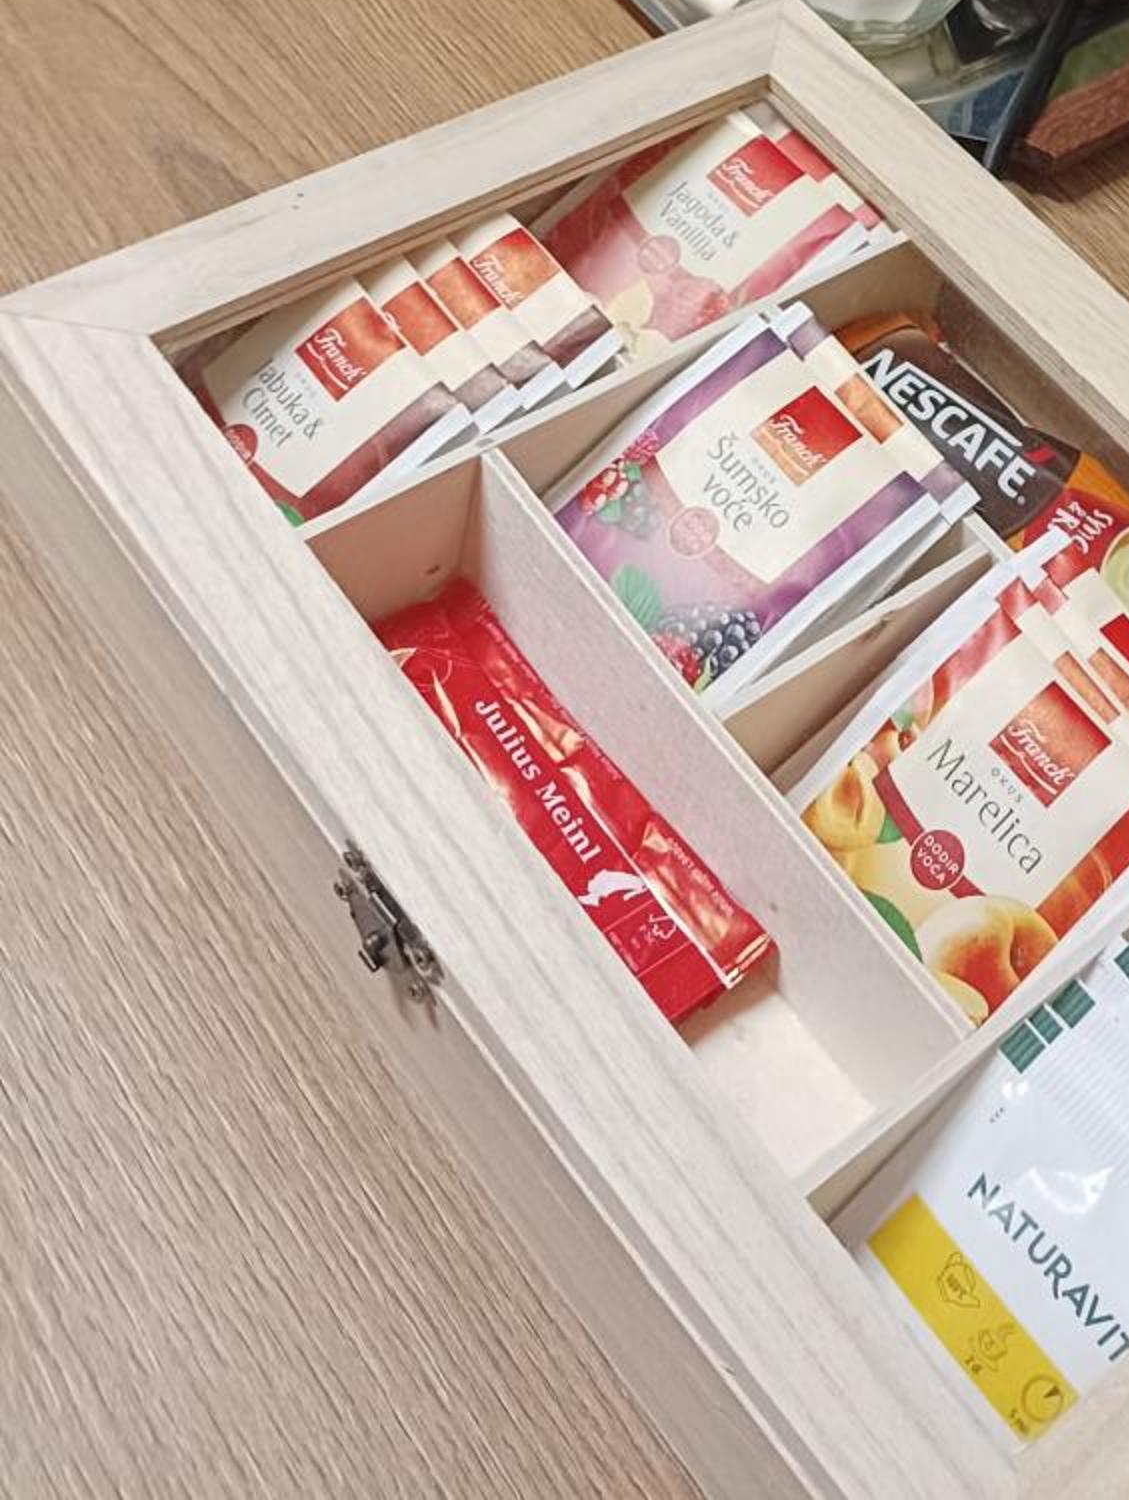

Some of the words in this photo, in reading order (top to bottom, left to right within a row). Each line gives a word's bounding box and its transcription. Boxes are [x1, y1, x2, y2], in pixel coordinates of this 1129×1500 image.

[703, 475, 754, 533] voće
[706, 432, 791, 530] Šumsko
[475, 699, 543, 782] Julius
[535, 781, 603, 864] Meinl
[1007, 719, 1074, 787] Franck
[926, 739, 1043, 874] Marelica
